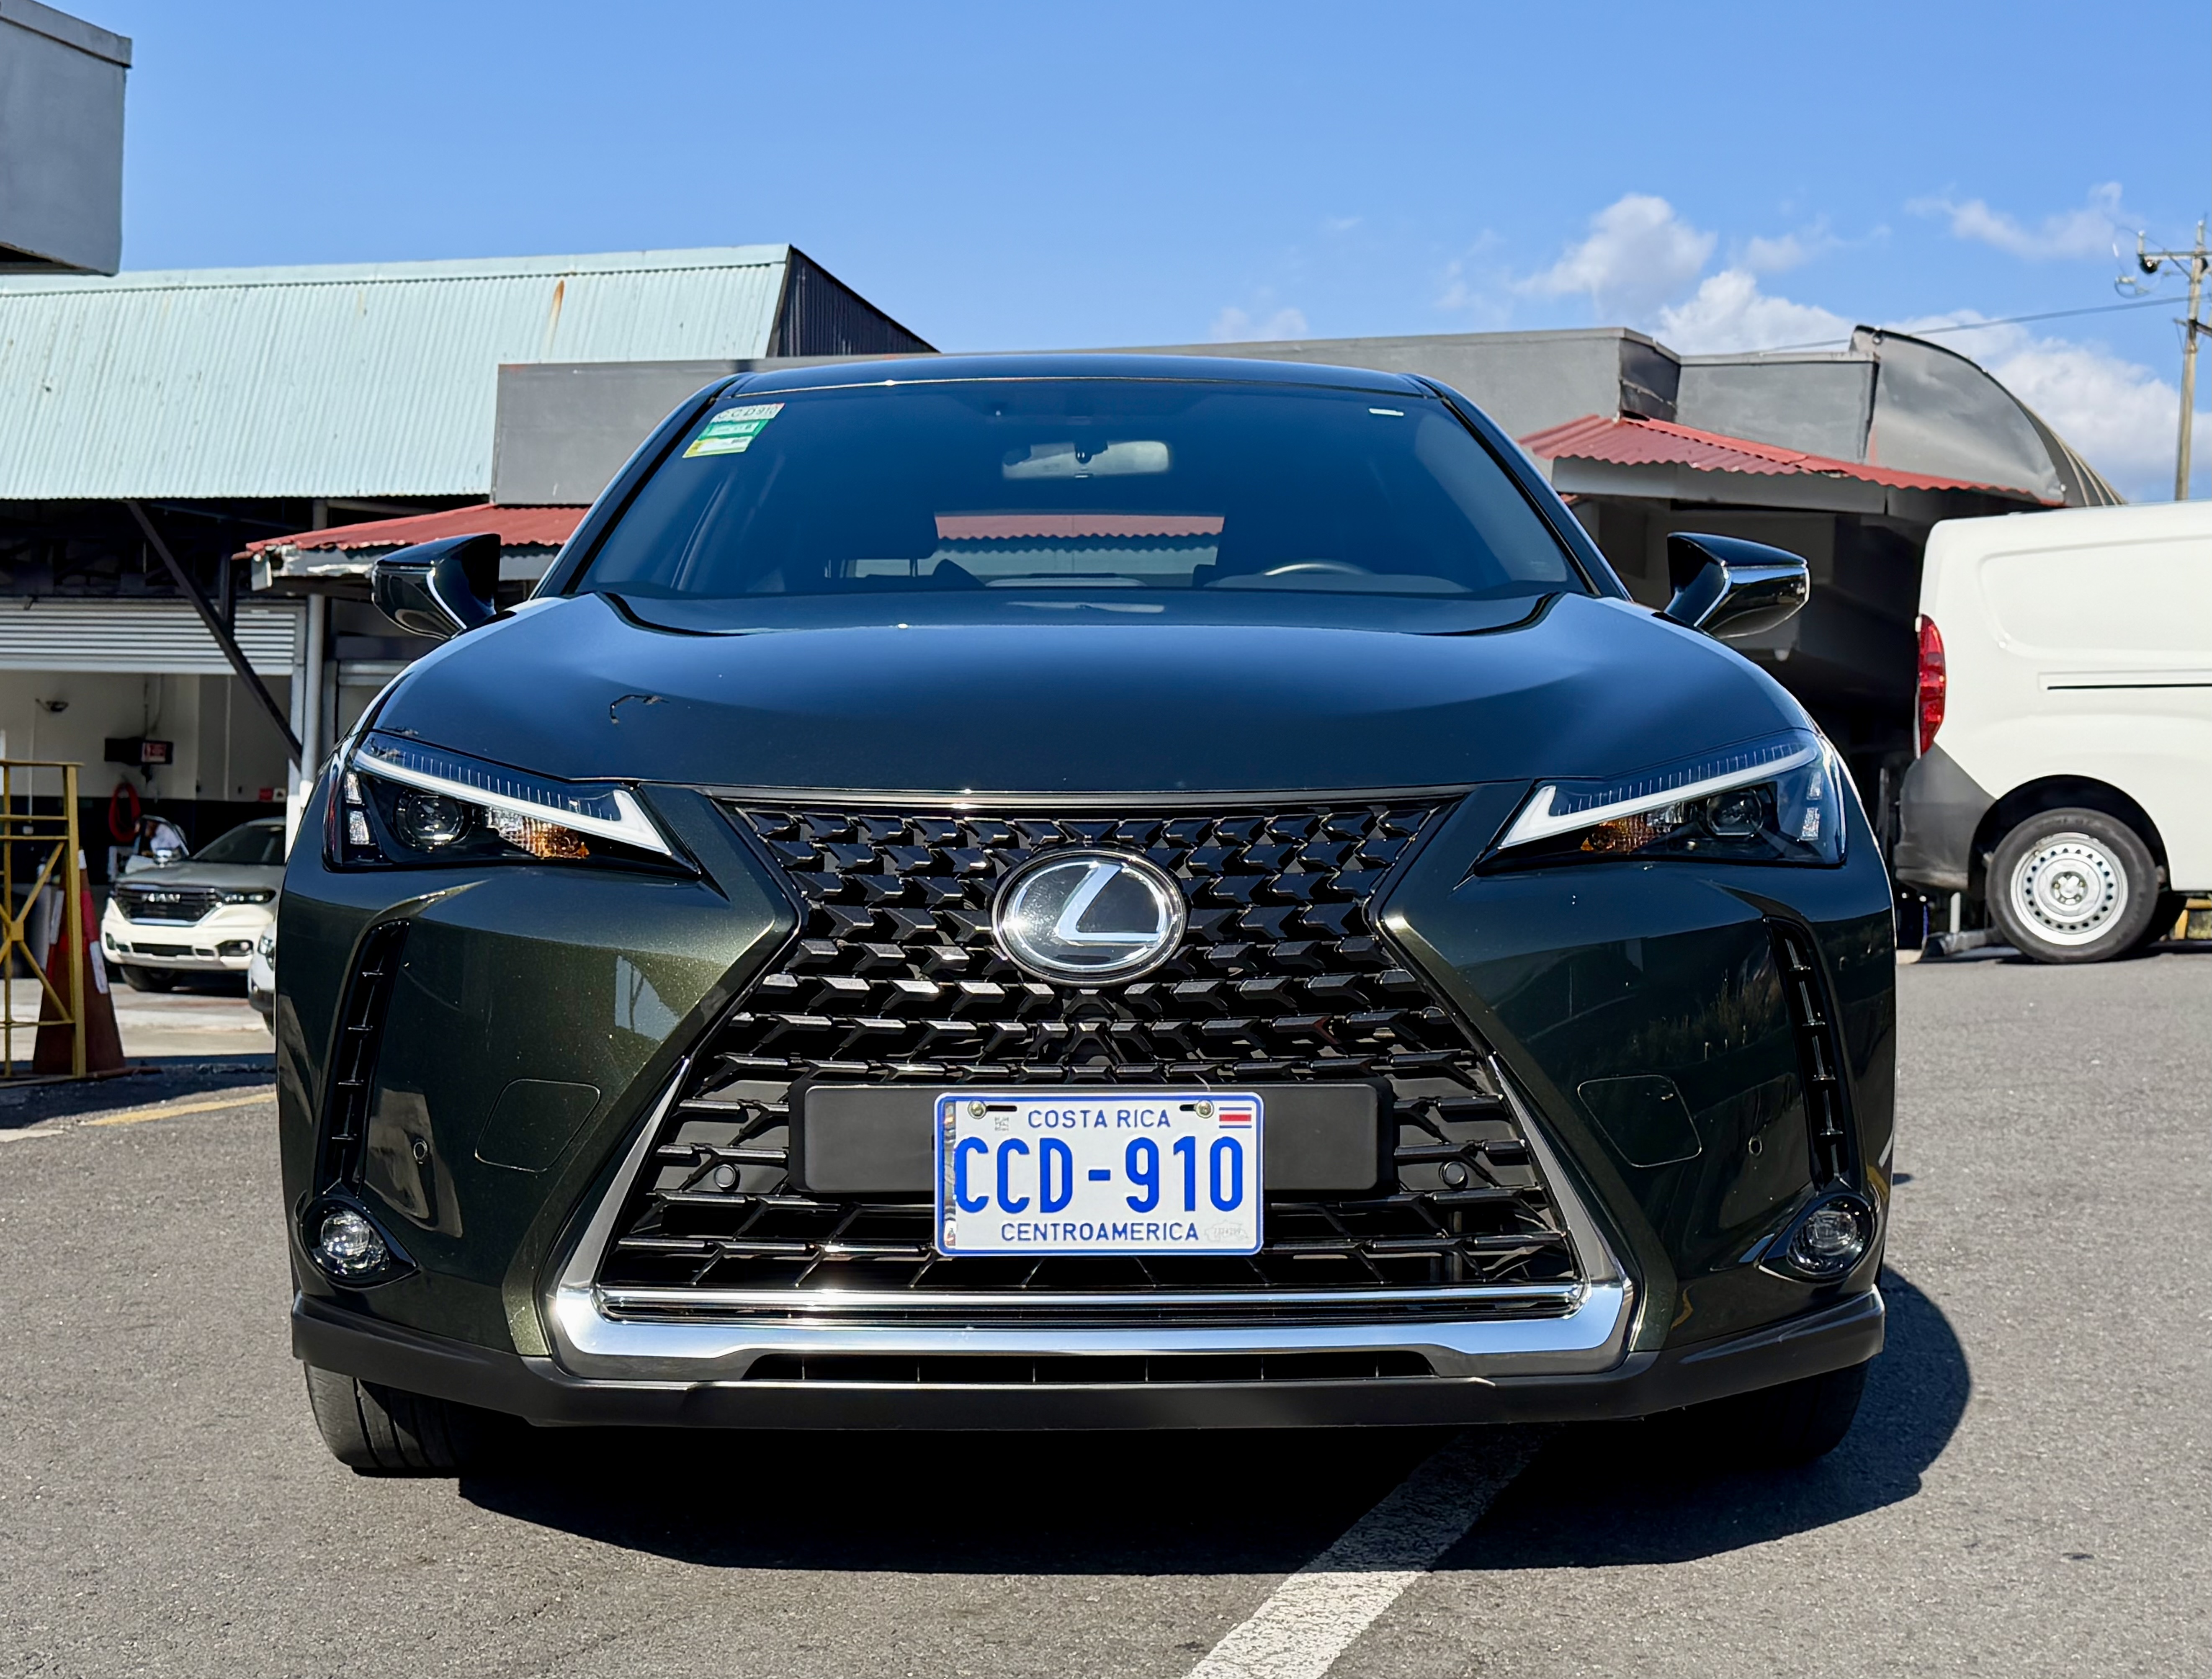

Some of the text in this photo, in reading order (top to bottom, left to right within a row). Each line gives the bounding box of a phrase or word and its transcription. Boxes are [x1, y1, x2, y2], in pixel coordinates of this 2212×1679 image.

[1028, 1109, 1171, 1128] COSTA RICA
[955, 1136, 1243, 1213] CCD-910
[1001, 1222, 1199, 1241] CENTROAMERICA
